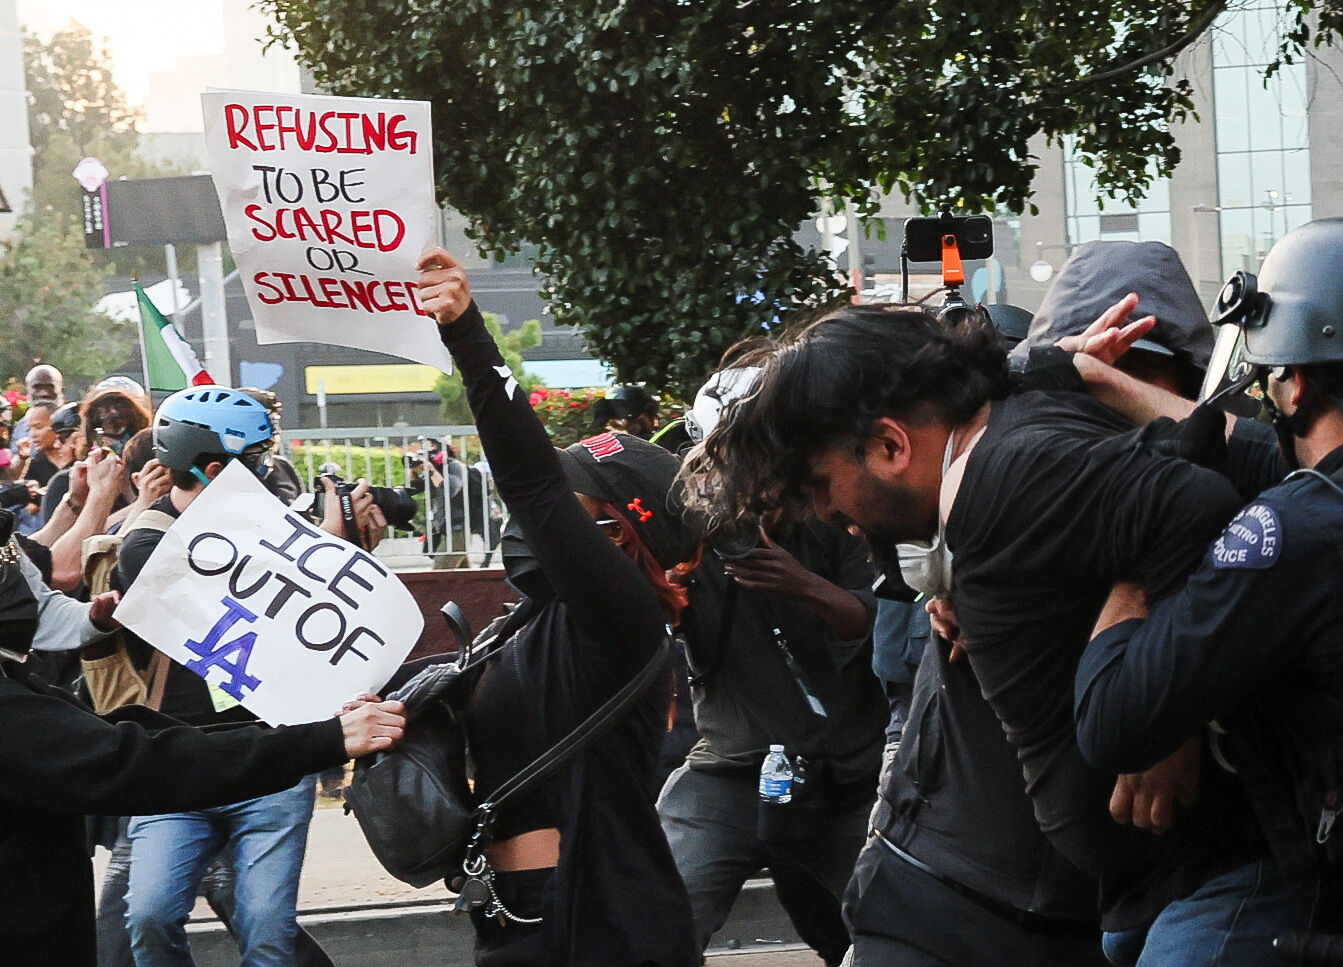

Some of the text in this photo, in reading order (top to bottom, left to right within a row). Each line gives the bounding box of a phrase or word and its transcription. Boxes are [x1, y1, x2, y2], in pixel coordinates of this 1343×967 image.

[224, 103, 418, 155] REFUSING
[252, 164, 366, 204] TO BE
[244, 204, 406, 252] SCARED
[306, 246, 375, 276] OR
[1245, 505, 1277, 557] ANGELES
[259, 513, 388, 611] ICE
[187, 531, 386, 666] OUT OF
